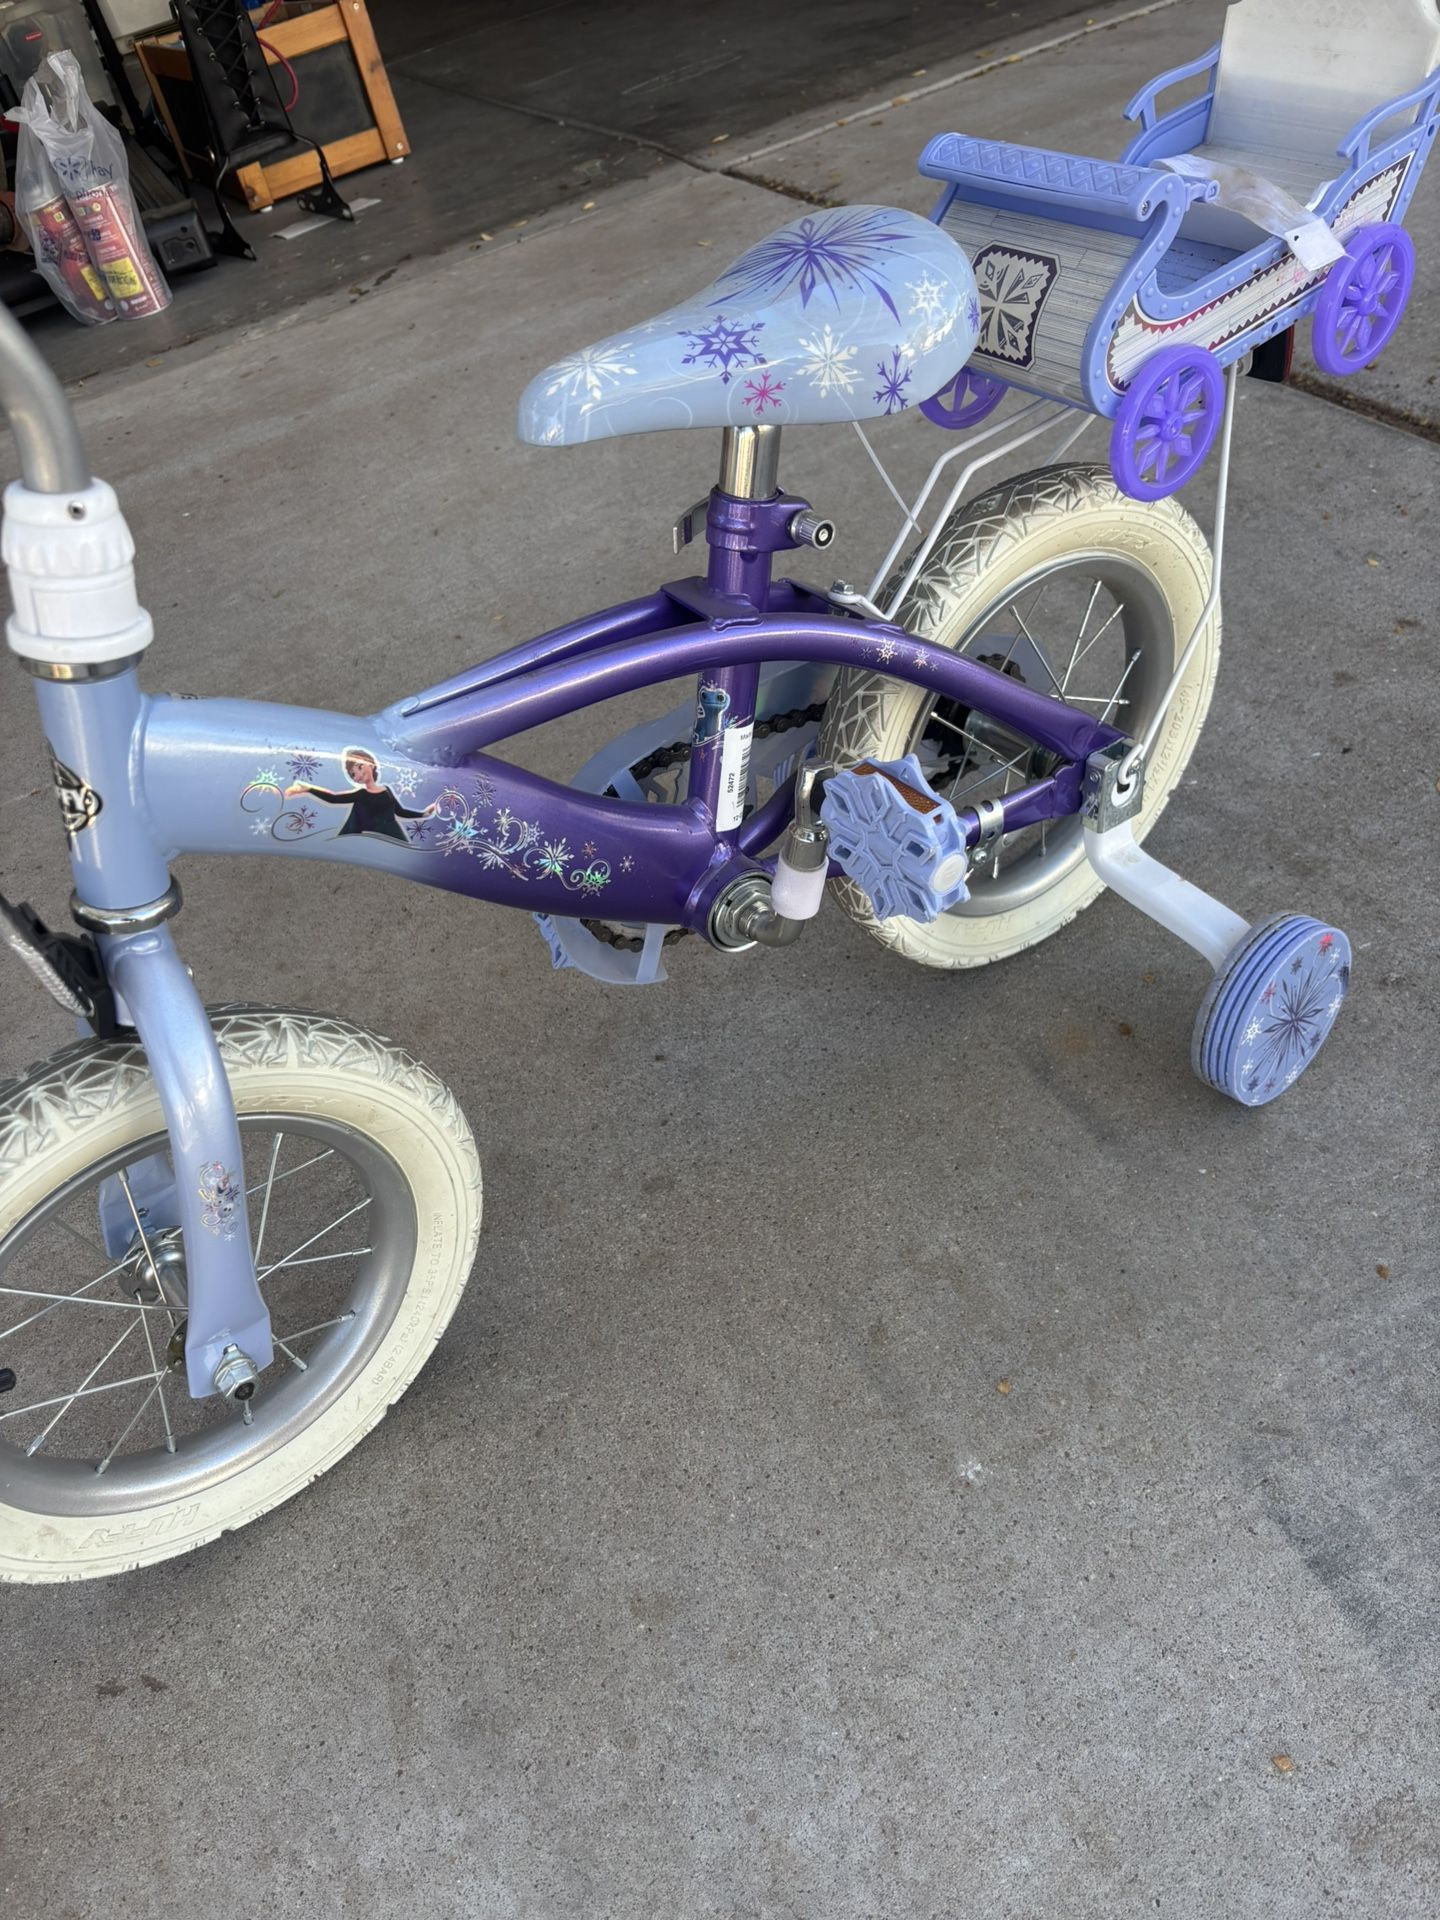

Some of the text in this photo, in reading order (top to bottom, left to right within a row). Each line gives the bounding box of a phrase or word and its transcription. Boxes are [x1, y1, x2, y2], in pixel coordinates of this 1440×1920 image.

[727, 772, 735, 793] 52472
[432, 1211, 443, 1249] INFLATE
[430, 1252, 441, 1265] TO
